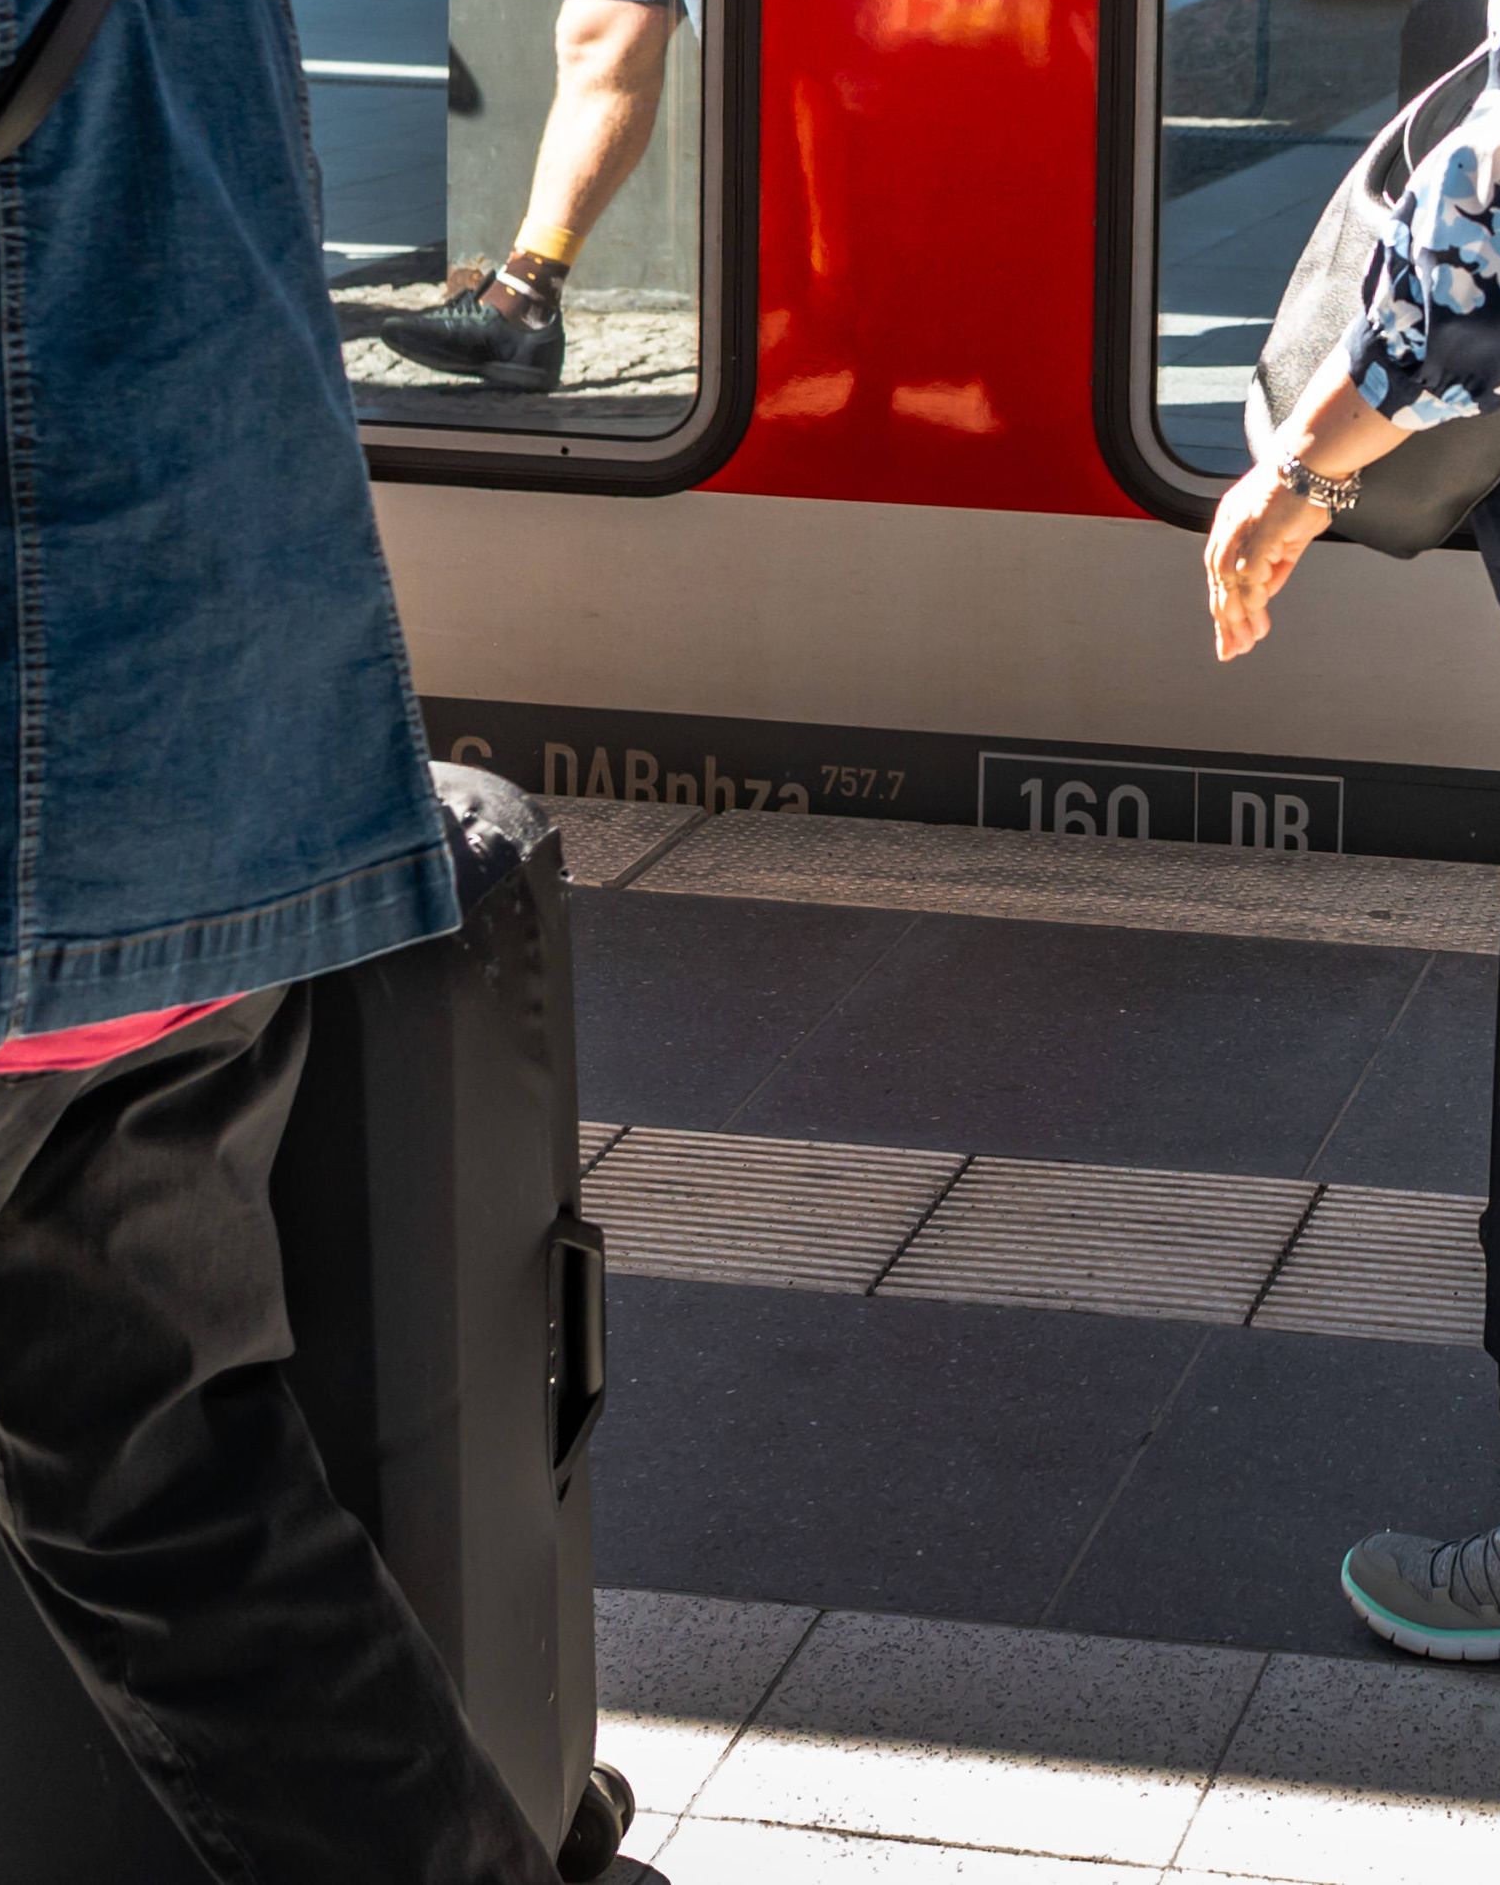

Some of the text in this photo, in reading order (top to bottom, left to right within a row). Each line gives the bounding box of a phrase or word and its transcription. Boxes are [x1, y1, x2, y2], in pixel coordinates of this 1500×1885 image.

[820, 764, 907, 802] 757.7
[1019, 777, 1310, 852] 160 DB
